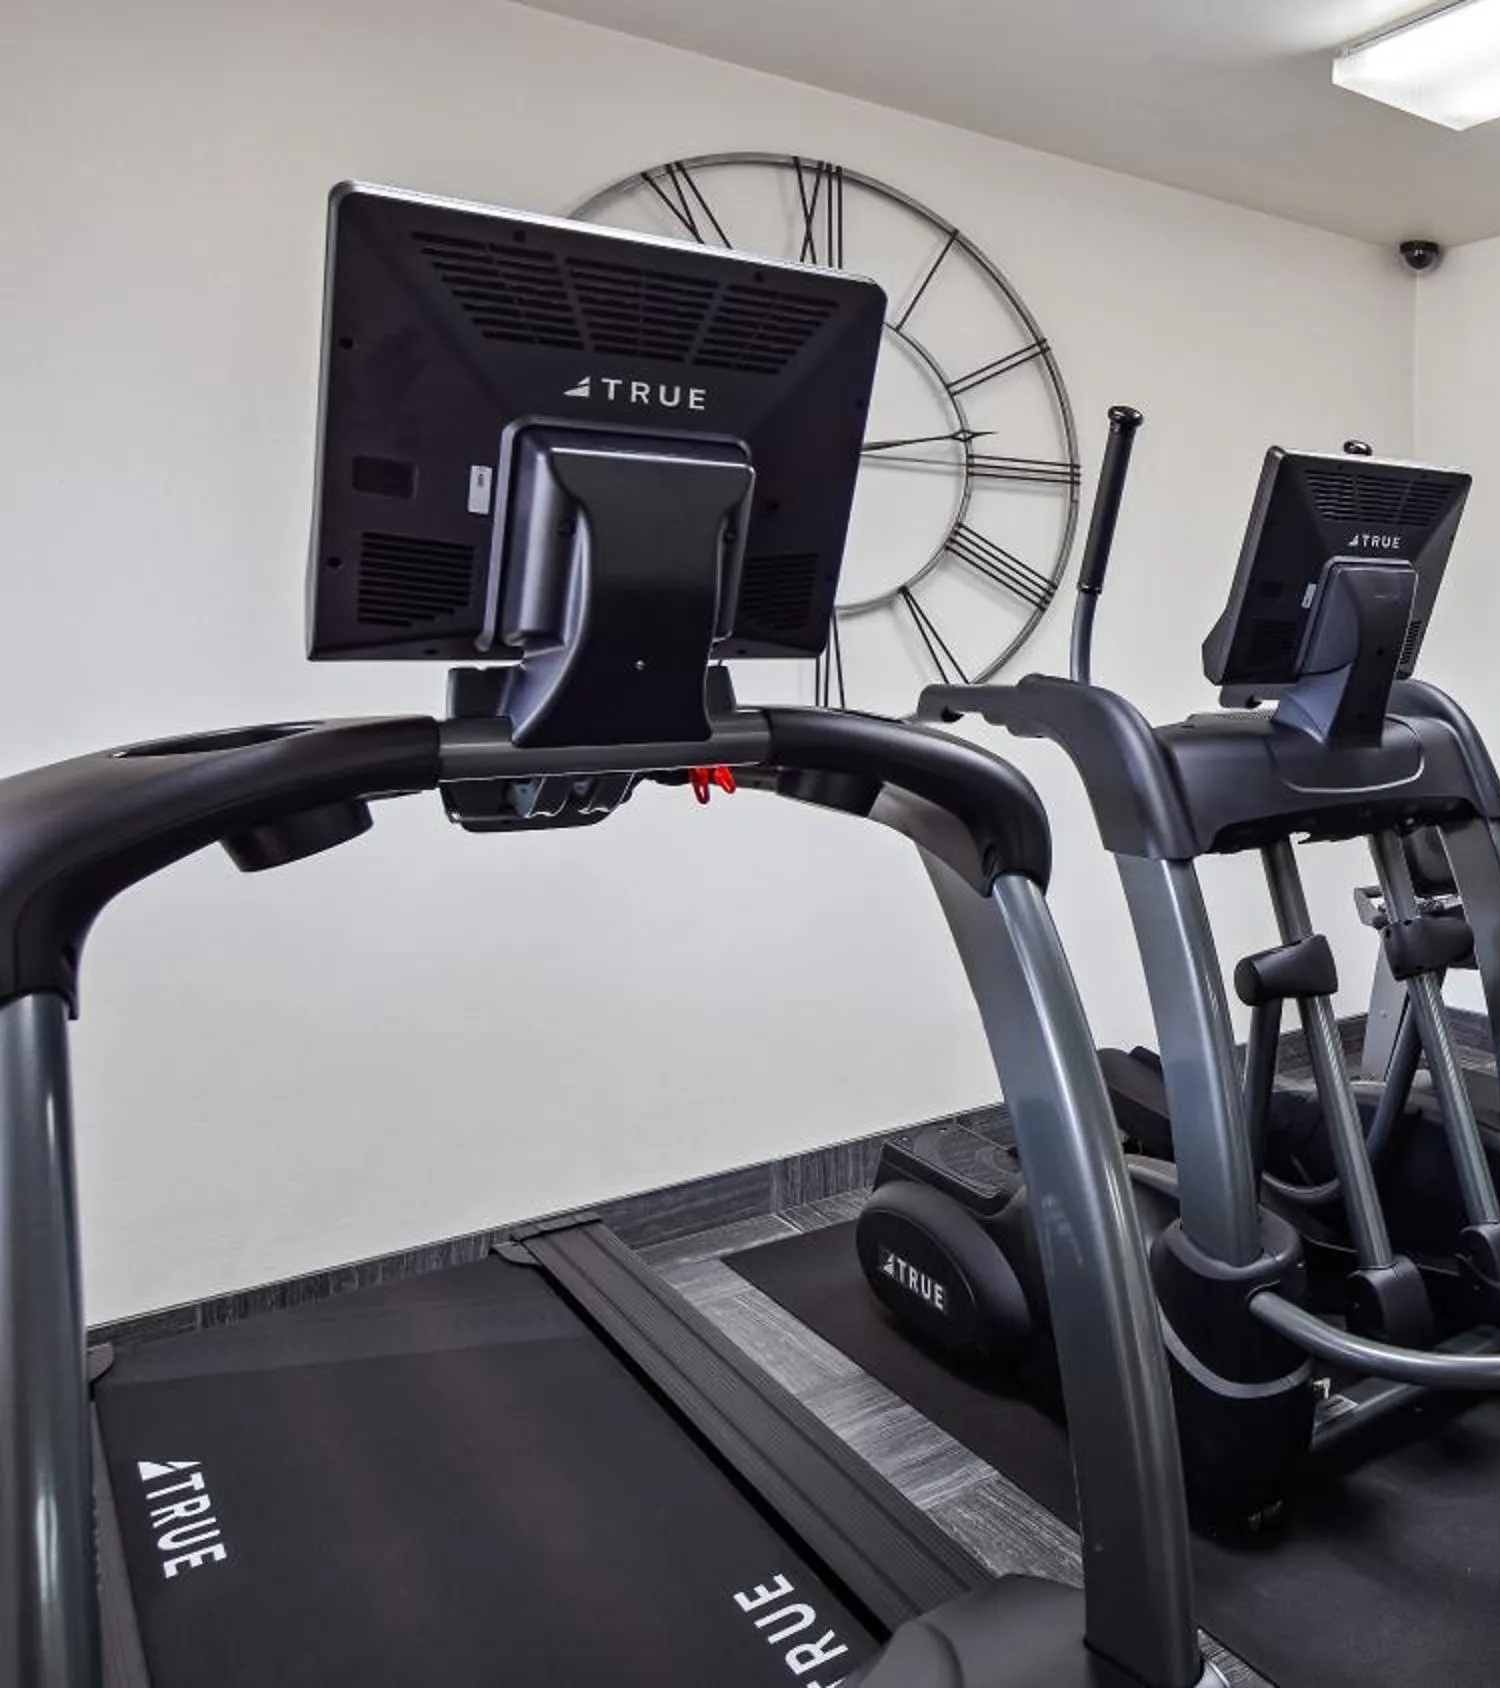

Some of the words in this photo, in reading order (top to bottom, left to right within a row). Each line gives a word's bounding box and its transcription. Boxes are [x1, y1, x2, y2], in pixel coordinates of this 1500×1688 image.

[601, 377, 706, 410] TRUE
[1362, 534, 1401, 549] TRUE
[897, 1257, 944, 1311] TRUE
[145, 1471, 227, 1579] TRUE
[733, 1573, 849, 1688] RUE
